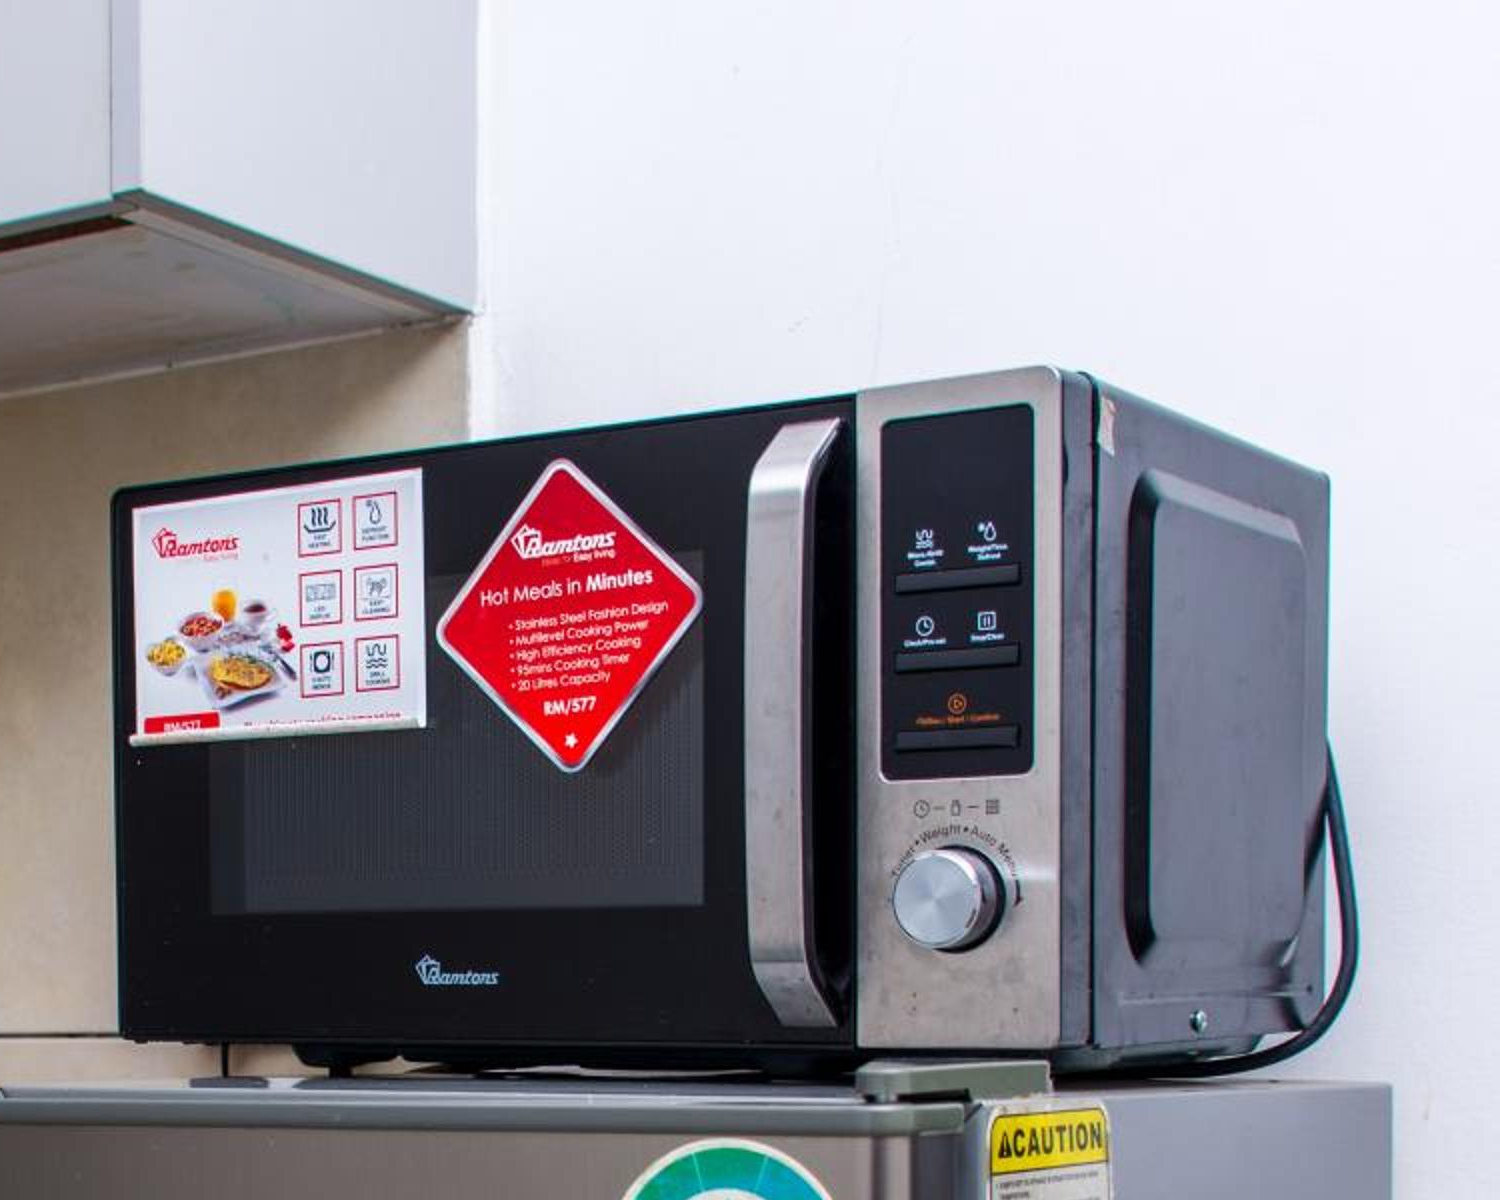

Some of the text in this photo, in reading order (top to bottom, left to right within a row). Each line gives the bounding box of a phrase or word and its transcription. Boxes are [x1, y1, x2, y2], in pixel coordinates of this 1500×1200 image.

[156, 530, 240, 557] Ramtons
[516, 526, 617, 558] Ramtons
[479, 569, 654, 608] Hot Meals in Minutes
[515, 601, 669, 631] Stainless Steel Fashion Design
[515, 619, 649, 646] Multilevel Cooking Power
[516, 635, 642, 663] High Efficiency Cooking
[517, 652, 630, 676] 95mins Cooking Timer
[518, 671, 611, 692] 20 Litres Capacity
[543, 695, 597, 716] RM/577
[918, 824, 962, 844] Weight
[969, 825, 998, 846] Auto
[419, 956, 499, 985] Ramtons
[1013, 1120, 1103, 1159] CAUTION
